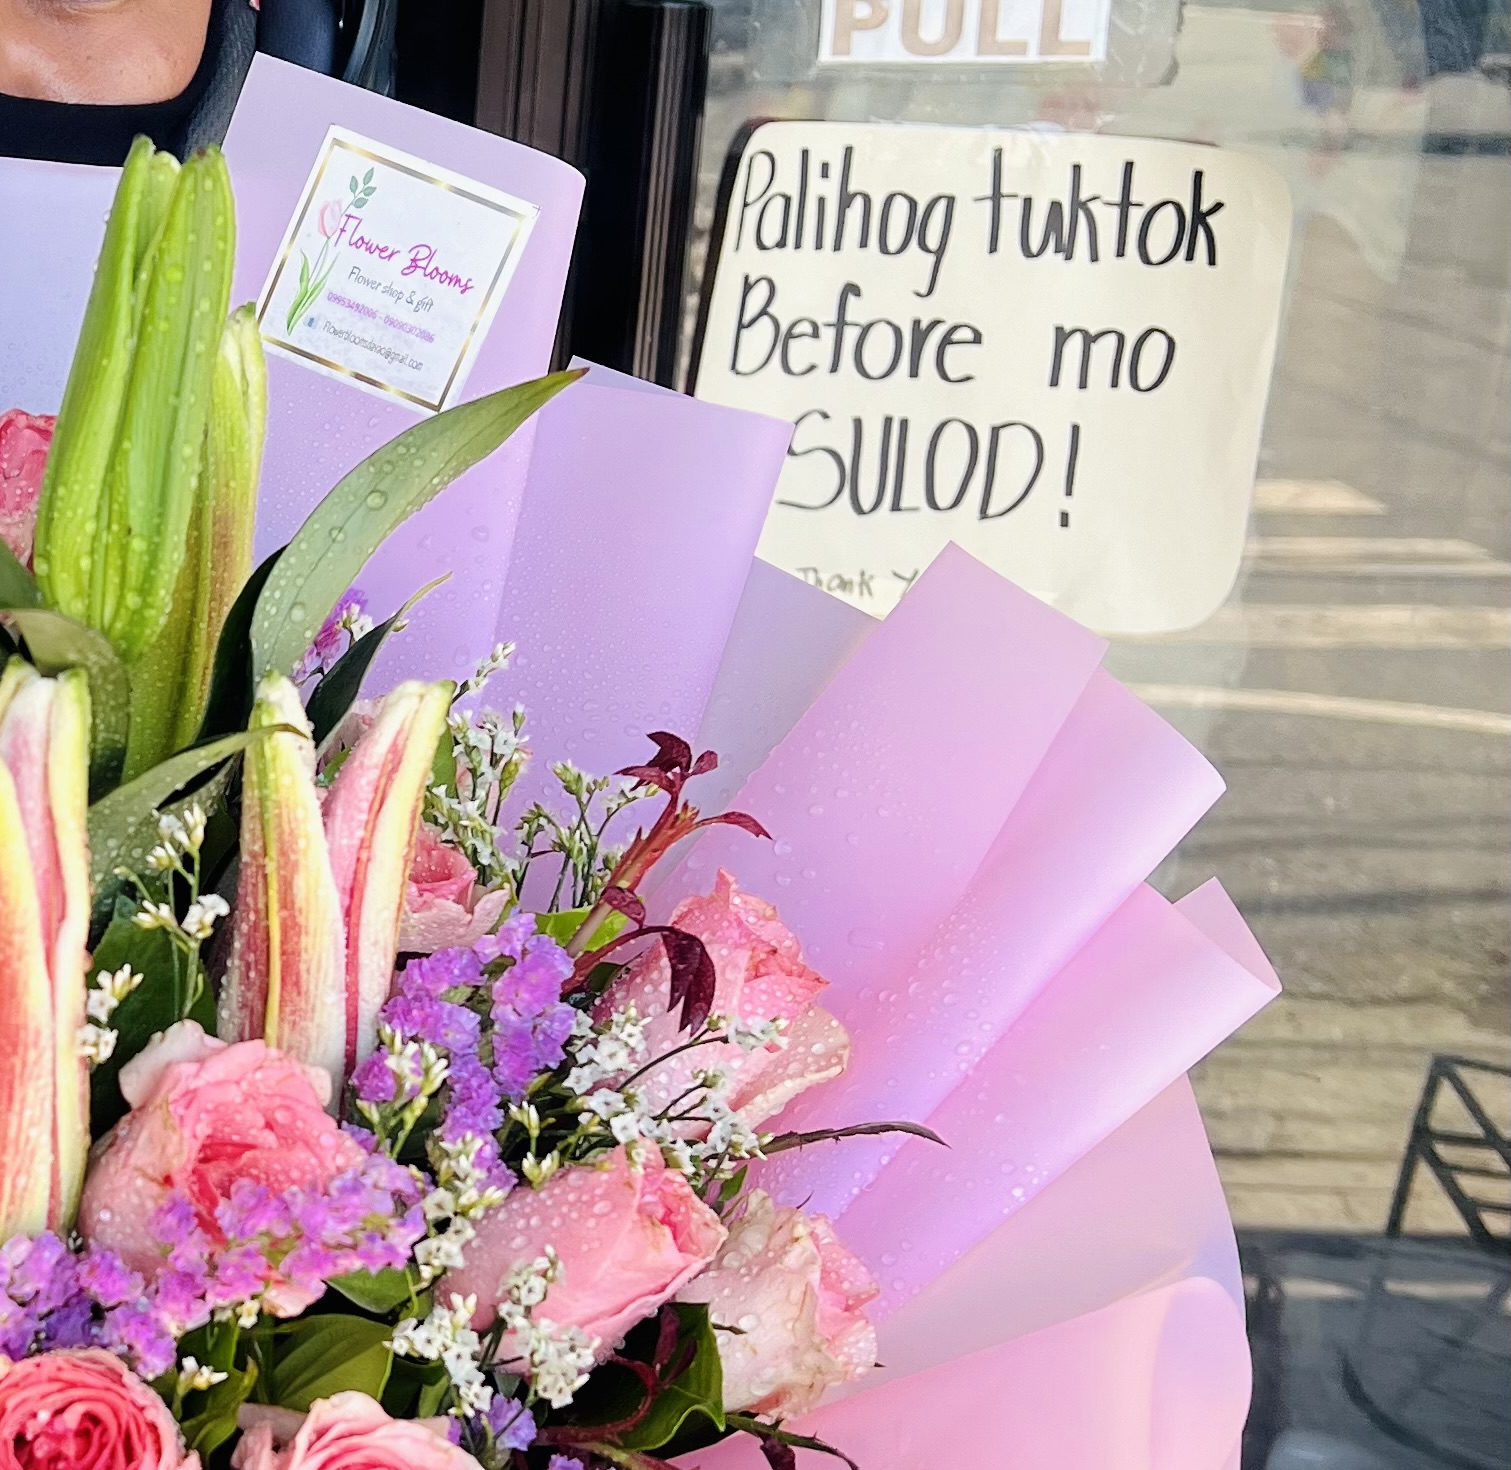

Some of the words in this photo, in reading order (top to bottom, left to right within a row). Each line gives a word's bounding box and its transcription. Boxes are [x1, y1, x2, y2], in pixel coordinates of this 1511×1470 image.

[830, 0, 1092, 57] PULL
[334, 213, 400, 261] Flower
[401, 243, 475, 295] Blooms
[734, 145, 957, 299] Palihog
[974, 146, 1225, 267] tuktok
[348, 265, 382, 294] Flower
[381, 280, 404, 304] shop
[413, 294, 435, 314] gift
[729, 273, 983, 384] Before
[1049, 325, 1176, 392] mo
[776, 409, 1080, 528] SULOD!
